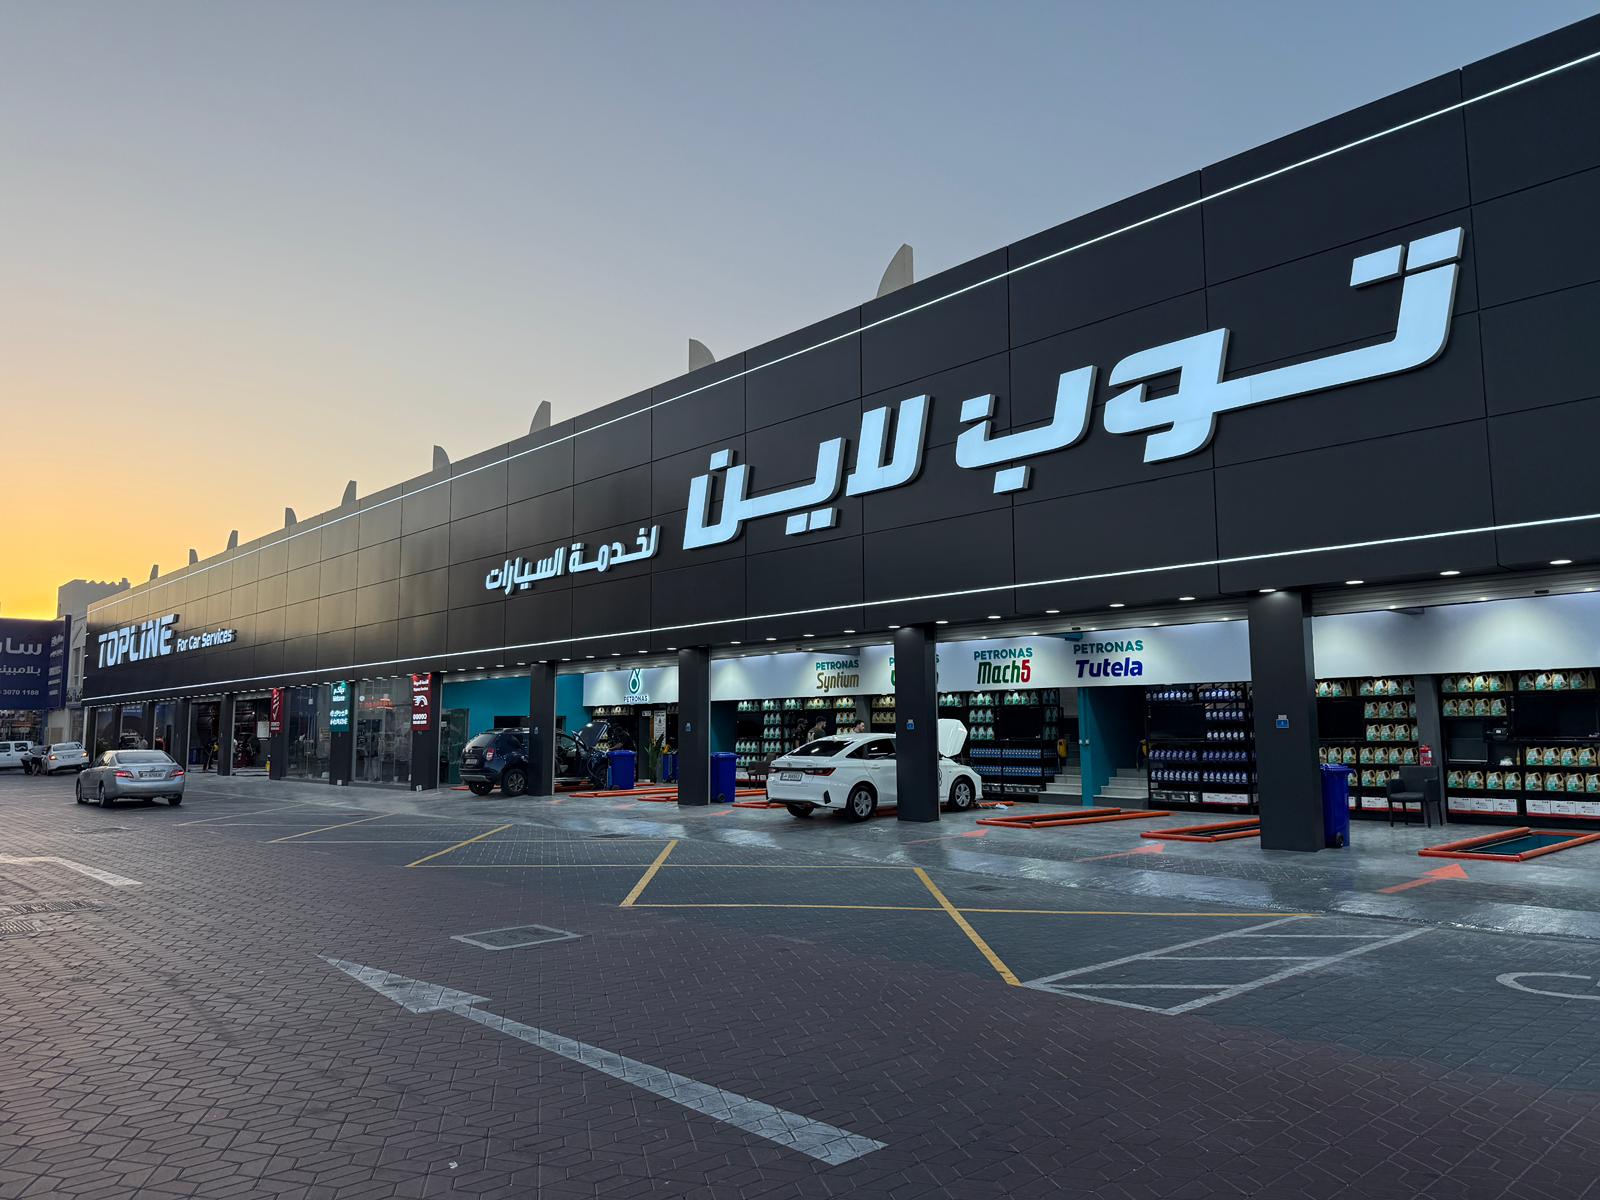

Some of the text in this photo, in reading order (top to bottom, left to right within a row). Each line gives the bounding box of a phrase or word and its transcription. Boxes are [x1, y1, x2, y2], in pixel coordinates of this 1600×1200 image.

[683, 227, 1464, 550] توب لاين
[485, 525, 661, 596] لخدمة السيارات
[176, 628, 236, 652] For Car Services
[1073, 639, 1144, 655] PETRONAS
[973, 647, 1033, 661] PETRONAS
[815, 659, 859, 671] PETRONAS
[977, 659, 1032, 685] Mach5
[1075, 657, 1144, 678] Tutela
[816, 671, 859, 693] Syntium
[623, 695, 649, 703] PETRONAS
